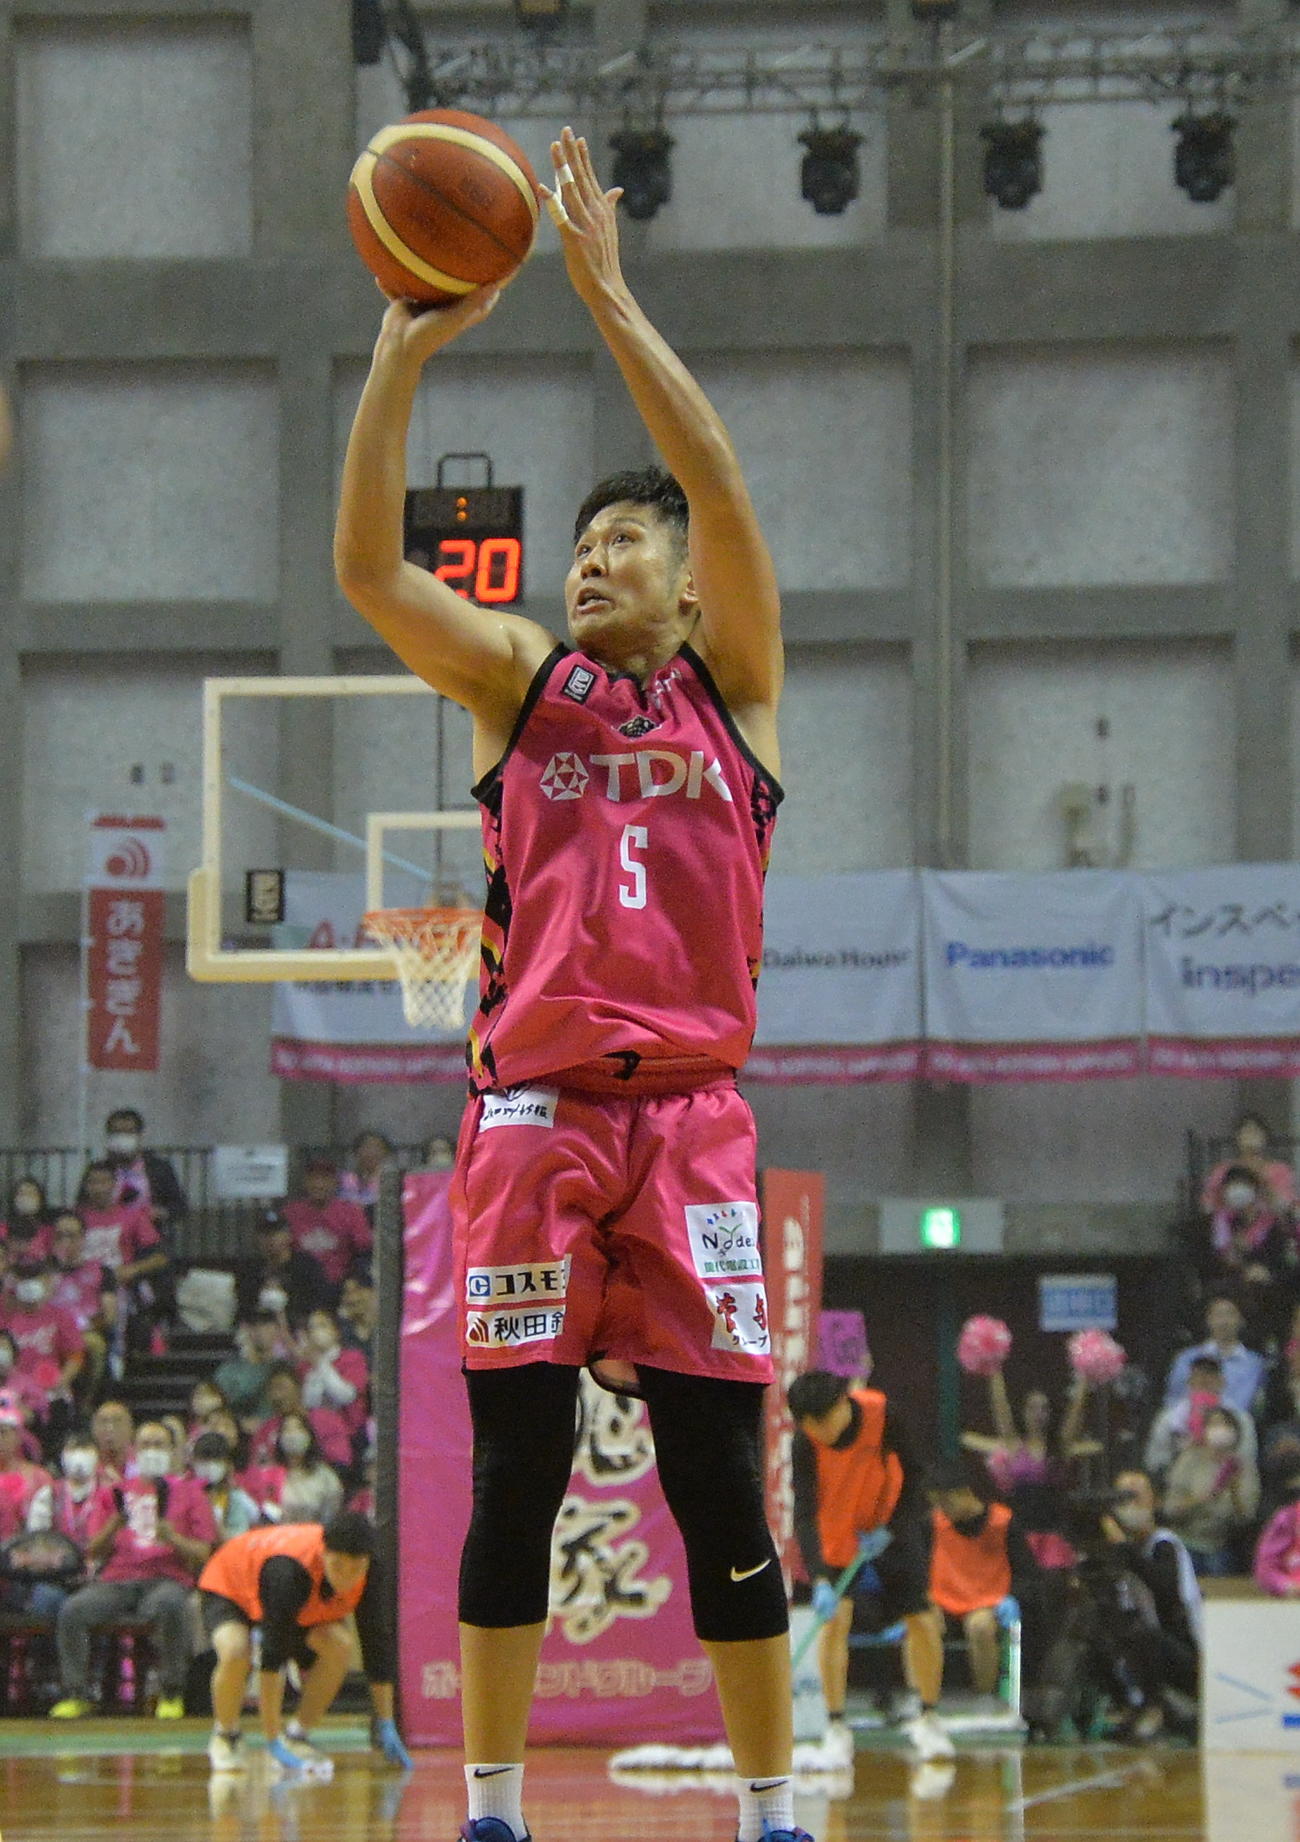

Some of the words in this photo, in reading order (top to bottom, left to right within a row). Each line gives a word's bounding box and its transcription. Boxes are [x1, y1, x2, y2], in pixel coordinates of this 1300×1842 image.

[434, 538, 521, 602] 20
[589, 750, 733, 802] TDK
[619, 824, 648, 909] 5
[1150, 902, 1300, 937] インスペ
[946, 941, 1113, 968] Panasonic
[702, 1228, 756, 1254] Node
[495, 1267, 566, 1296] コスモ
